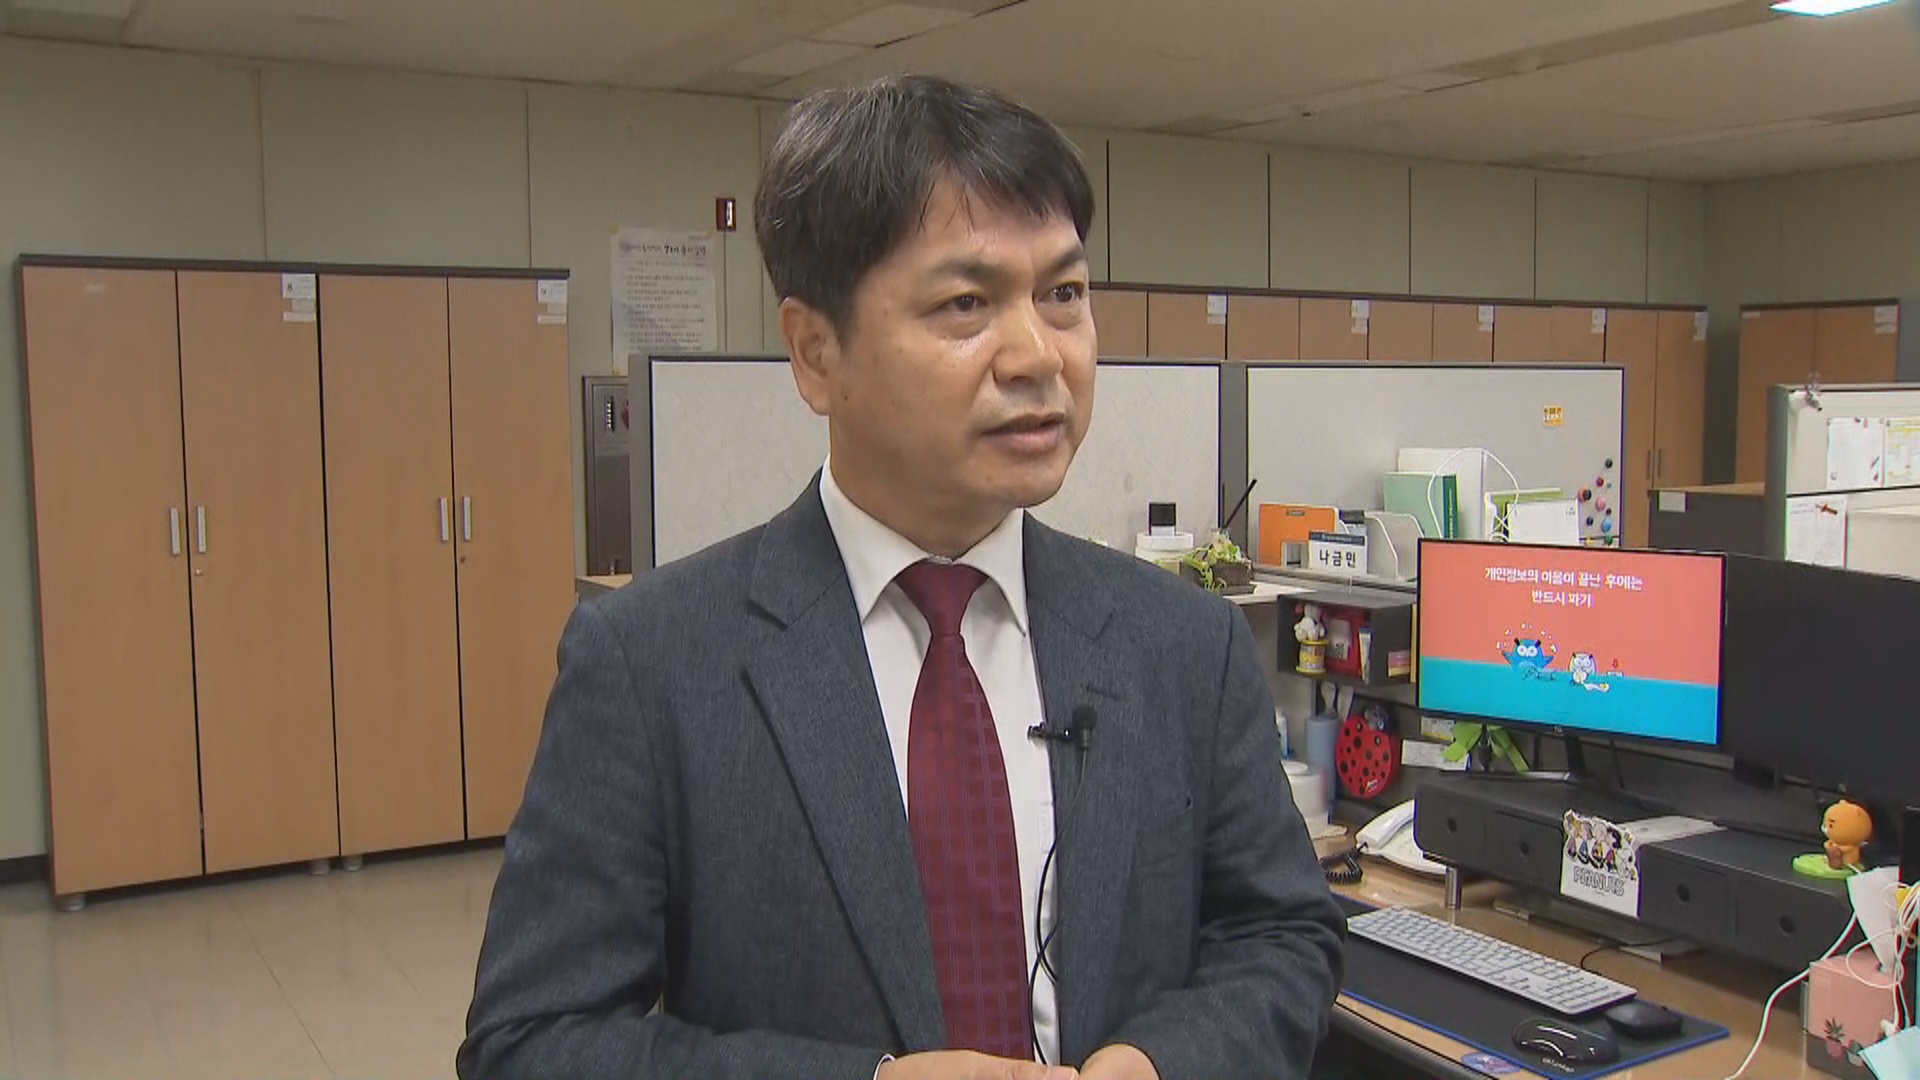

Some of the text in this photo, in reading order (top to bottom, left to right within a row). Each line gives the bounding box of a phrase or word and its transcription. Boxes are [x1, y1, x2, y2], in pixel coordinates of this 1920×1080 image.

[1485, 567, 1539, 583] 개인정보의
[1578, 571, 1601, 588] 끝난
[1605, 573, 1643, 591] 후에는
[1532, 589, 1591, 608] 반드시 파기
[1573, 866, 1626, 897] PEANUTS
